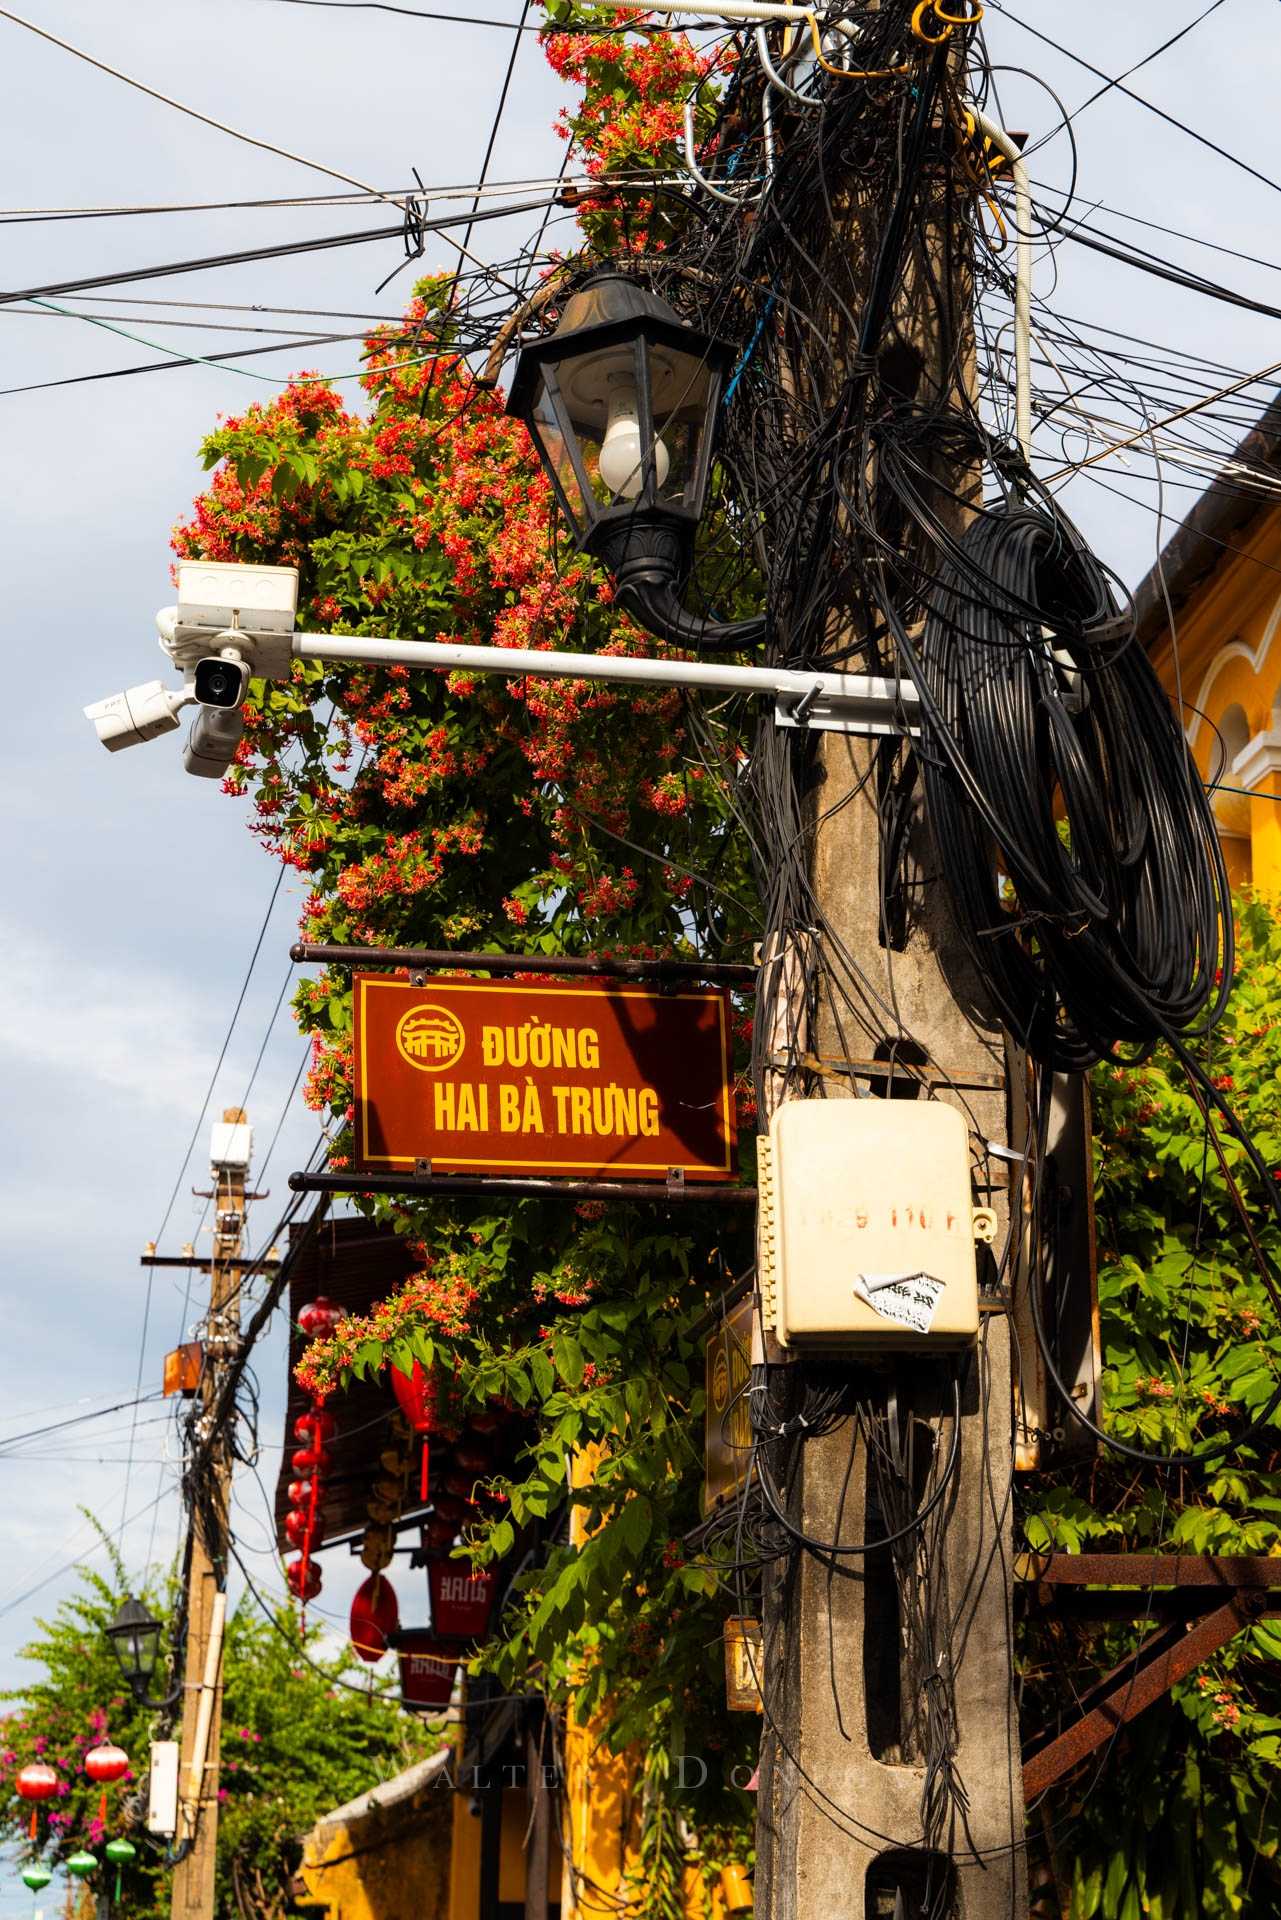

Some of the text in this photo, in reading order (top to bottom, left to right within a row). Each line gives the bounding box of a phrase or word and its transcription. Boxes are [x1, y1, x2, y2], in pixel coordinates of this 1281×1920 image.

[481, 1015, 600, 1069] ĐƯỜNG
[433, 1075, 660, 1137] HAI BÀ TRƯNG
